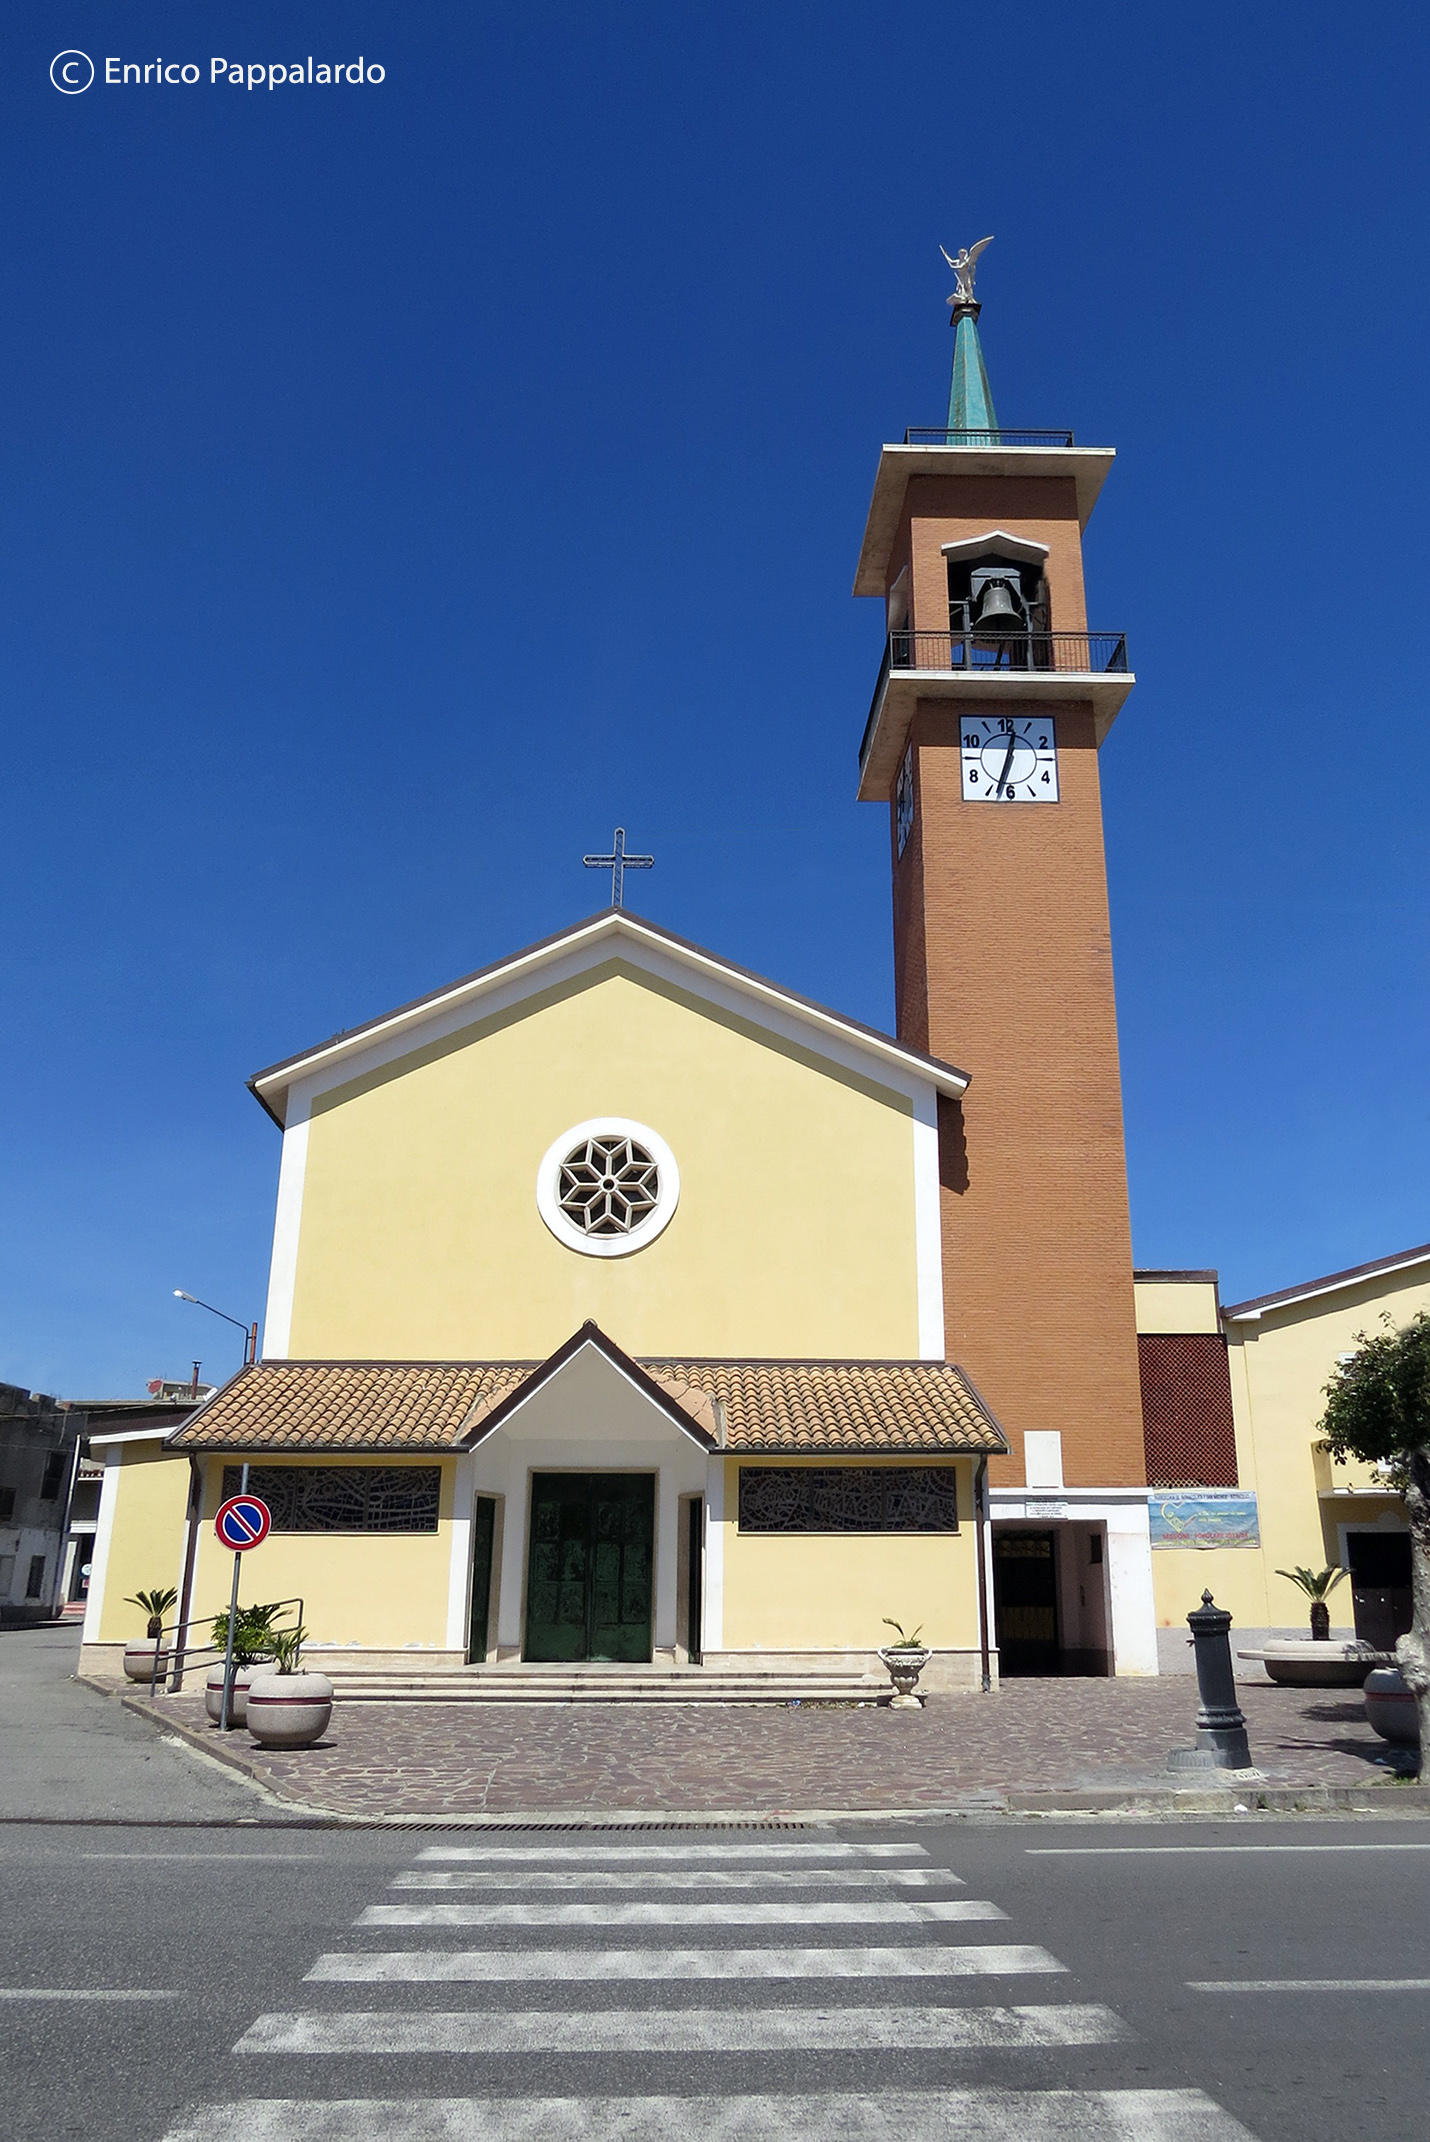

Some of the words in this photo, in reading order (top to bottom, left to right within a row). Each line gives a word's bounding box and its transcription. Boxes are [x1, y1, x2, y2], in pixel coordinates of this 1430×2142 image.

[998, 719, 1014, 733] 12
[963, 734, 980, 748] 10
[1039, 736, 1048, 749] 2
[969, 769, 979, 783] 8
[1041, 770, 1050, 784] 4
[1006, 785, 1015, 799] 6
